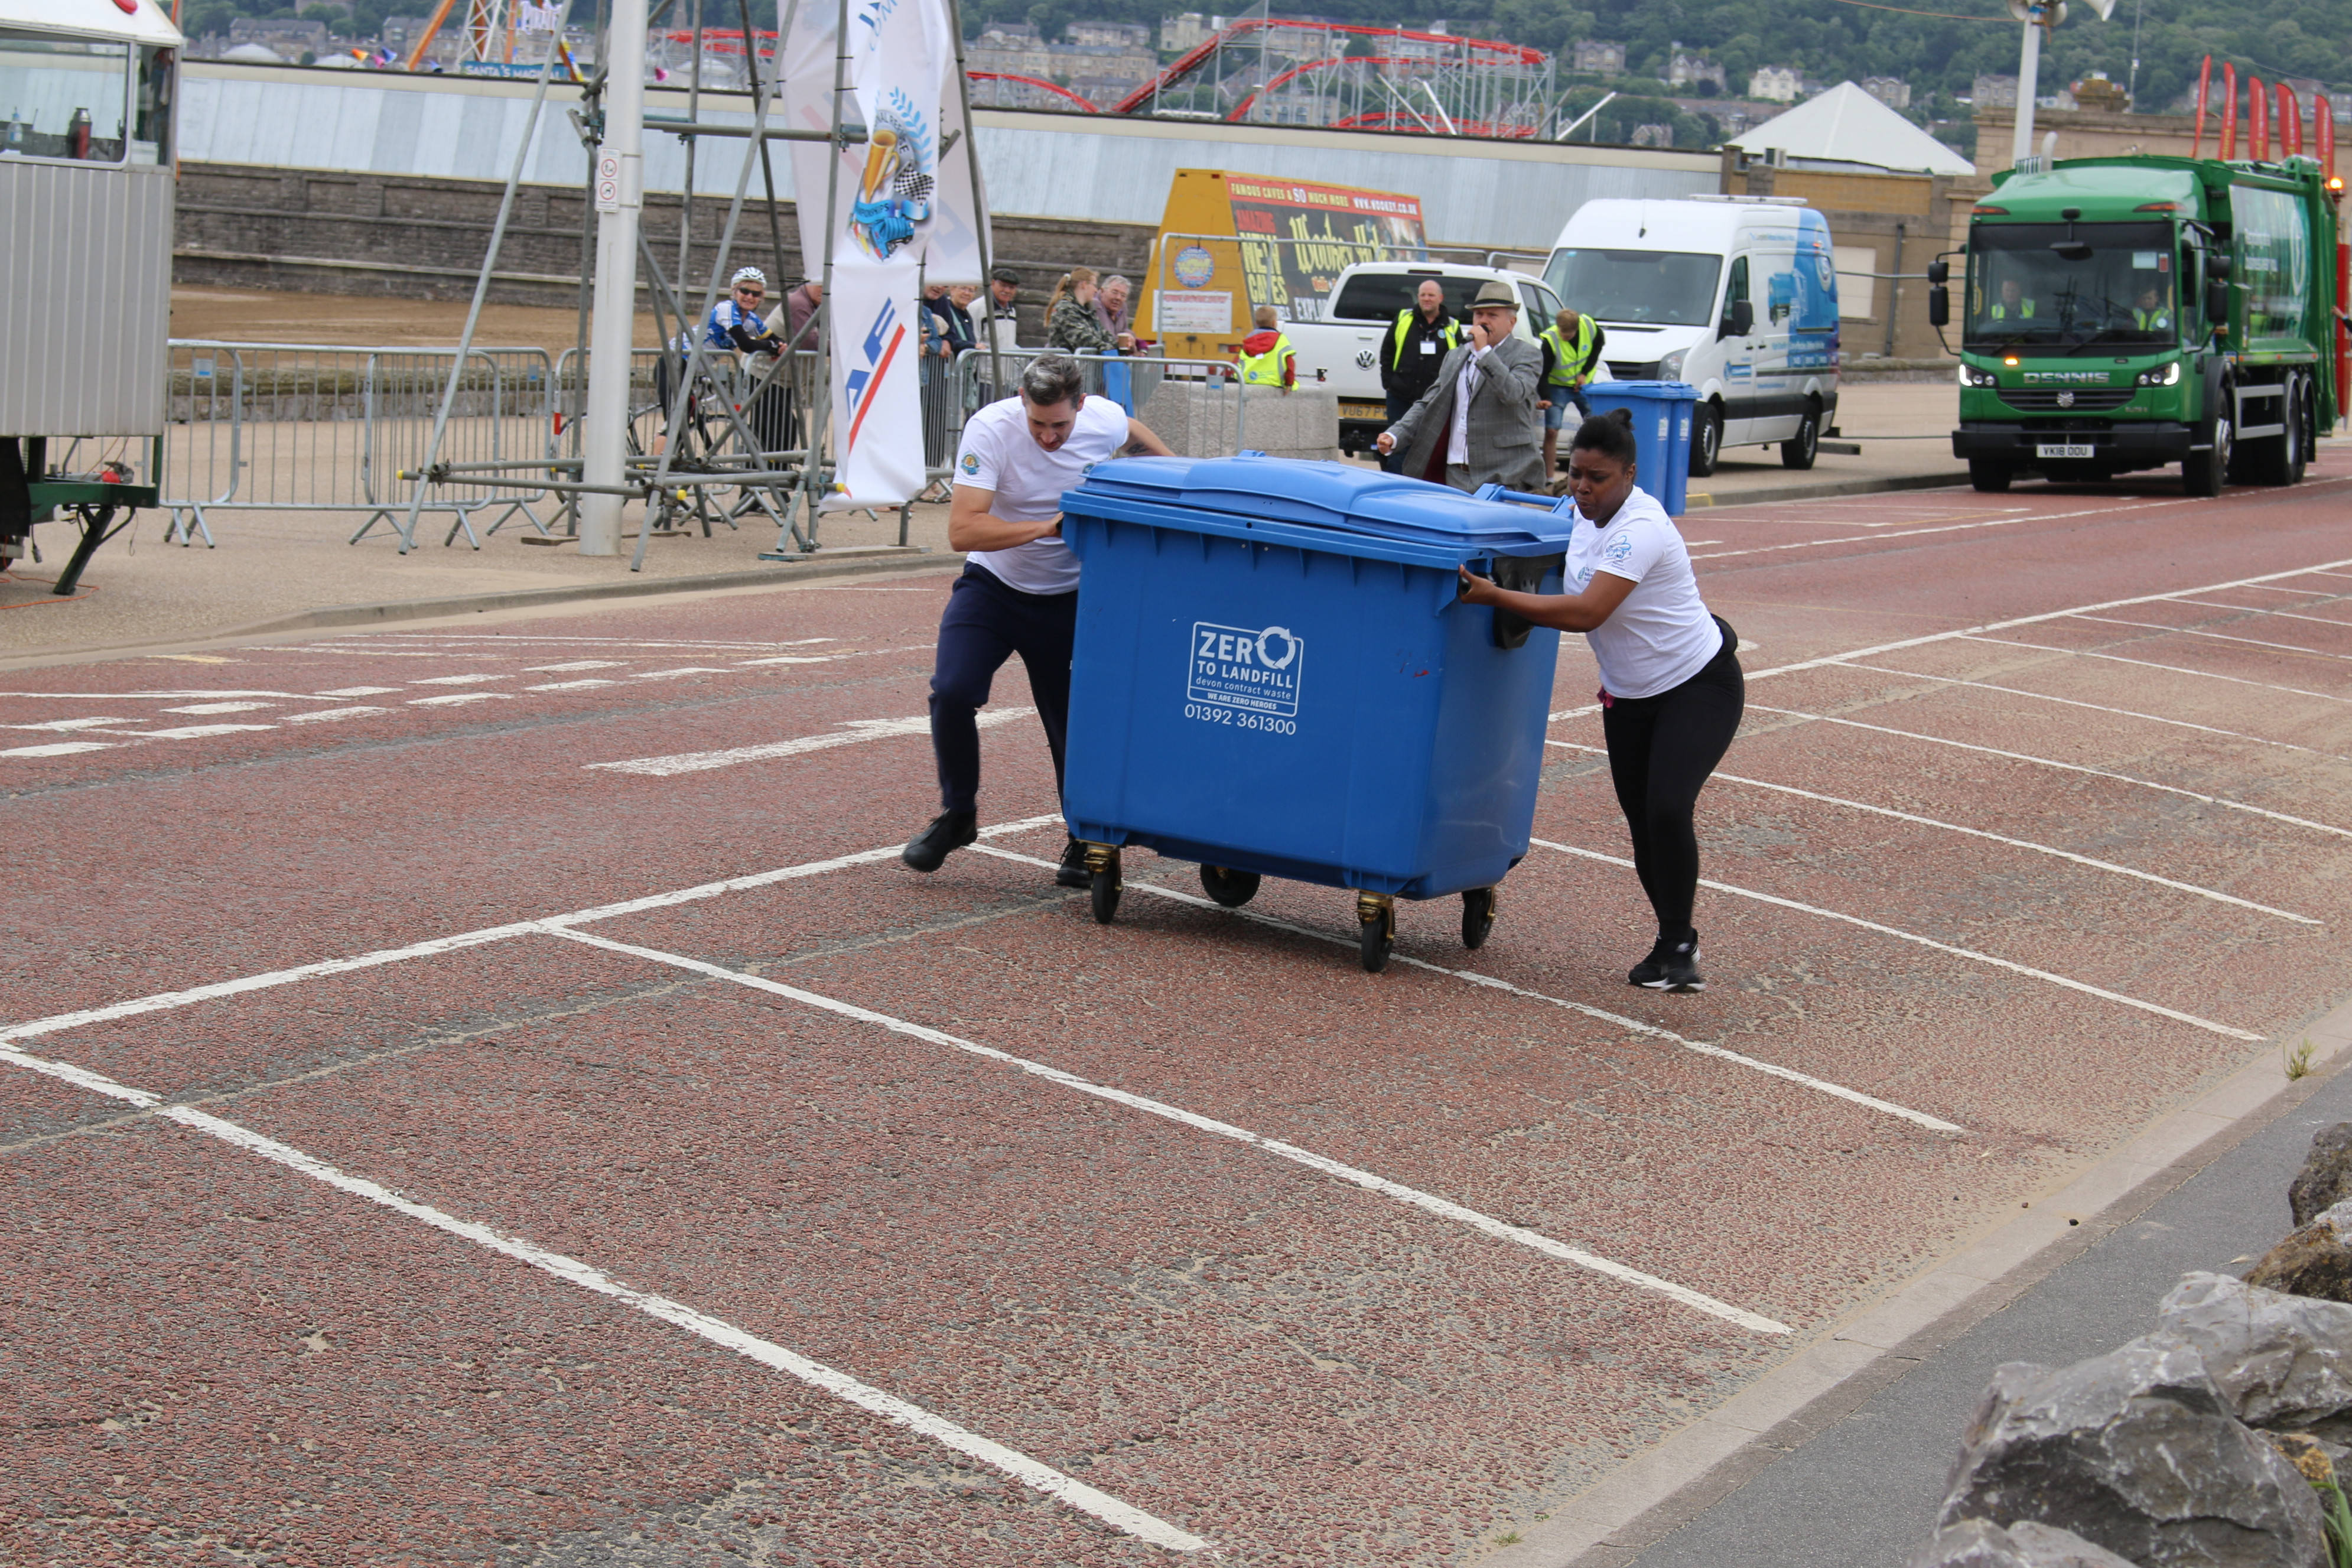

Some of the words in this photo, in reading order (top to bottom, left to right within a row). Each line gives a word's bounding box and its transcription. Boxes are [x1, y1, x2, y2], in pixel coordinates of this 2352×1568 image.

[1231, 183, 1261, 198] FAMOUS
[1262, 186, 1286, 200] CAVES
[1293, 187, 1307, 203] SO
[1307, 192, 1329, 205] MUCH
[1329, 194, 1349, 207] MORE
[1239, 232, 1282, 275] NEW
[2023, 372, 2110, 384] DENNIS
[2043, 446, 2065, 457] VK18
[1198, 626, 1296, 671] ZERO
[1197, 660, 1216, 676] TO
[1221, 664, 1293, 688] LANDFILL
[1196, 676, 1222, 688] devon
[1224, 682, 1261, 695] contract
[1263, 688, 1292, 700] waste
[1207, 692, 1218, 701] WE
[1218, 694, 1232, 702] ARE
[1232, 696, 1250, 706] ZERO
[1250, 699, 1277, 710] HEROES
[1184, 704, 1232, 725] 01392
[1237, 713, 1296, 736] 361300
